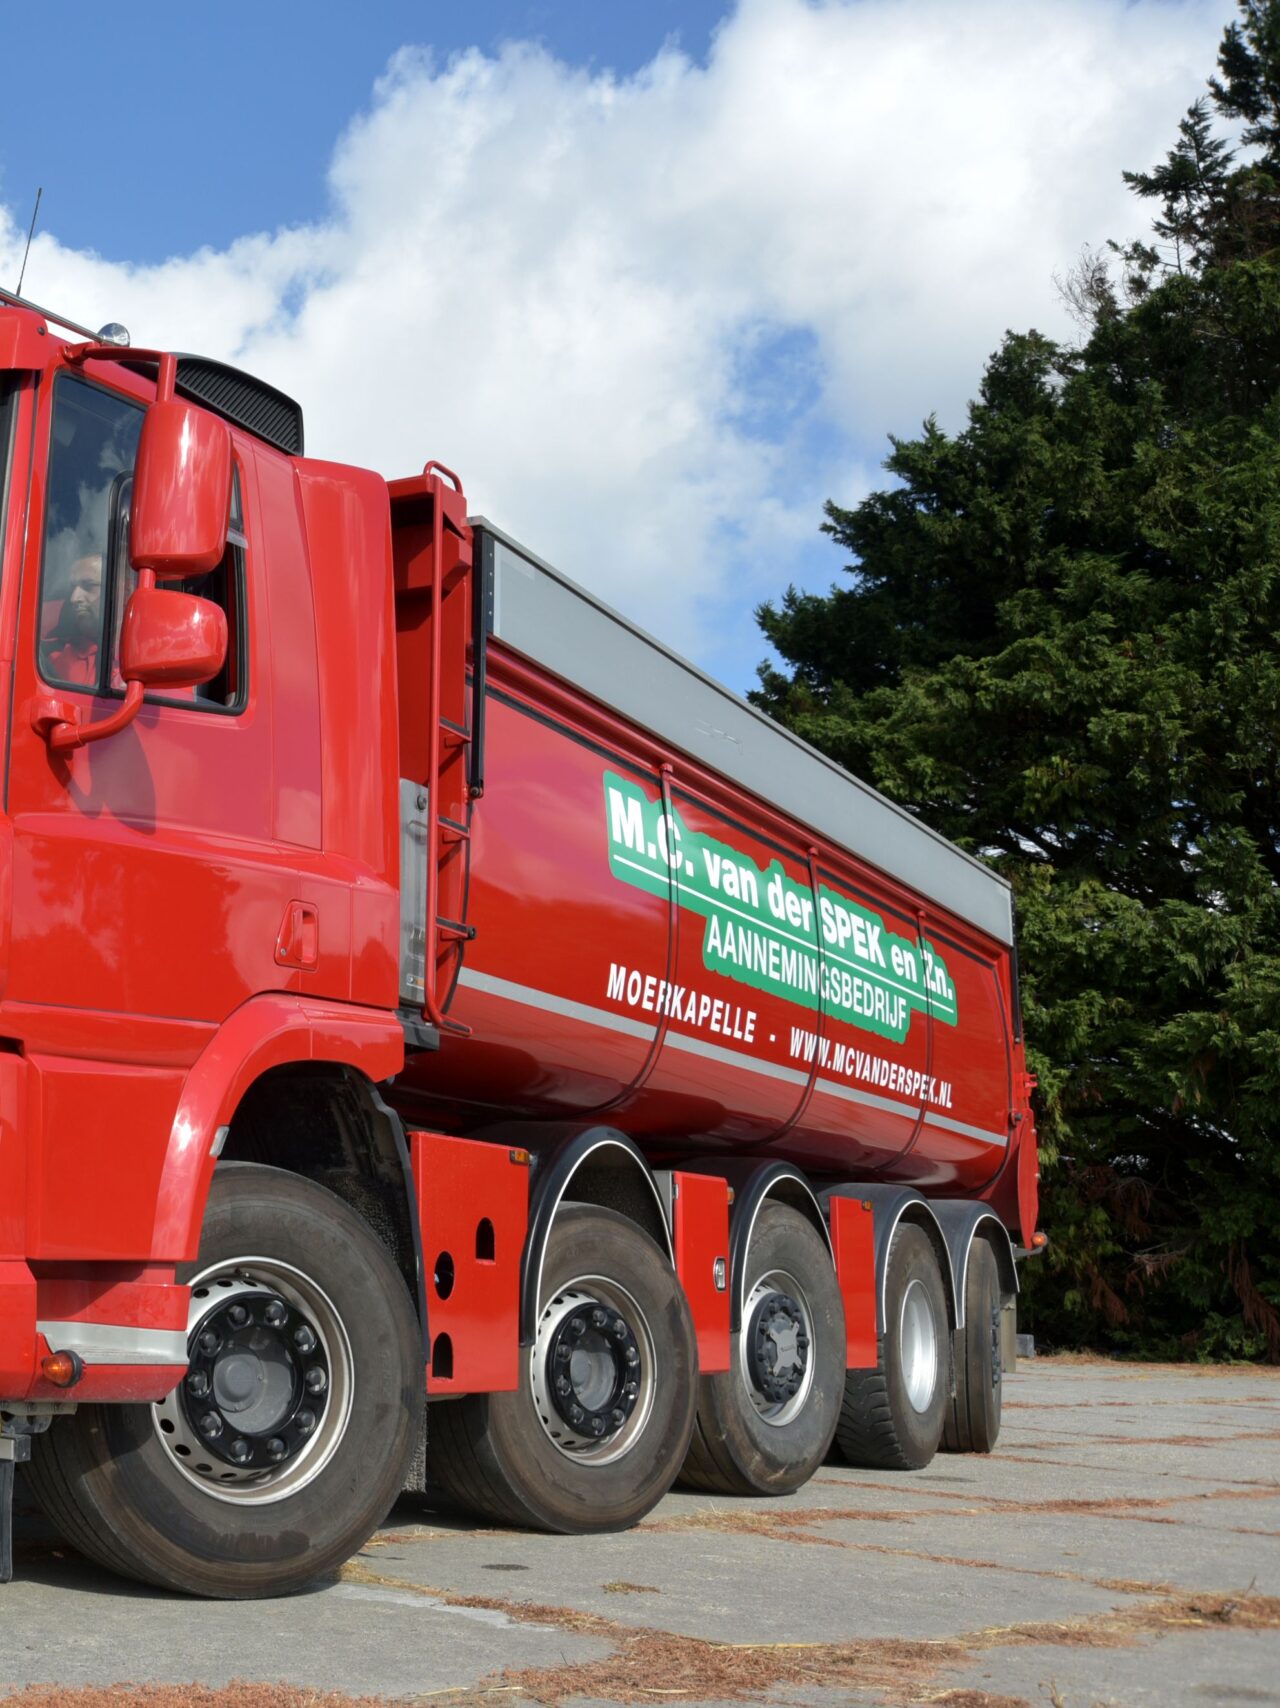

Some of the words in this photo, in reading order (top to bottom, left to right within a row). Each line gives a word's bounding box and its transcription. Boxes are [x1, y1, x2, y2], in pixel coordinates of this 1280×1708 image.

[608, 787, 694, 877] M.C.
[702, 847, 759, 908] van
[767, 873, 813, 932] der
[819, 896, 887, 969] SPEK
[891, 944, 917, 984] en
[606, 962, 757, 1043] MOERKAPELLE
[789, 1026, 953, 1109] WWW.MCVANDERSPEK.NL
[706, 914, 907, 1030] AANNEMINGSBEDRIJF
